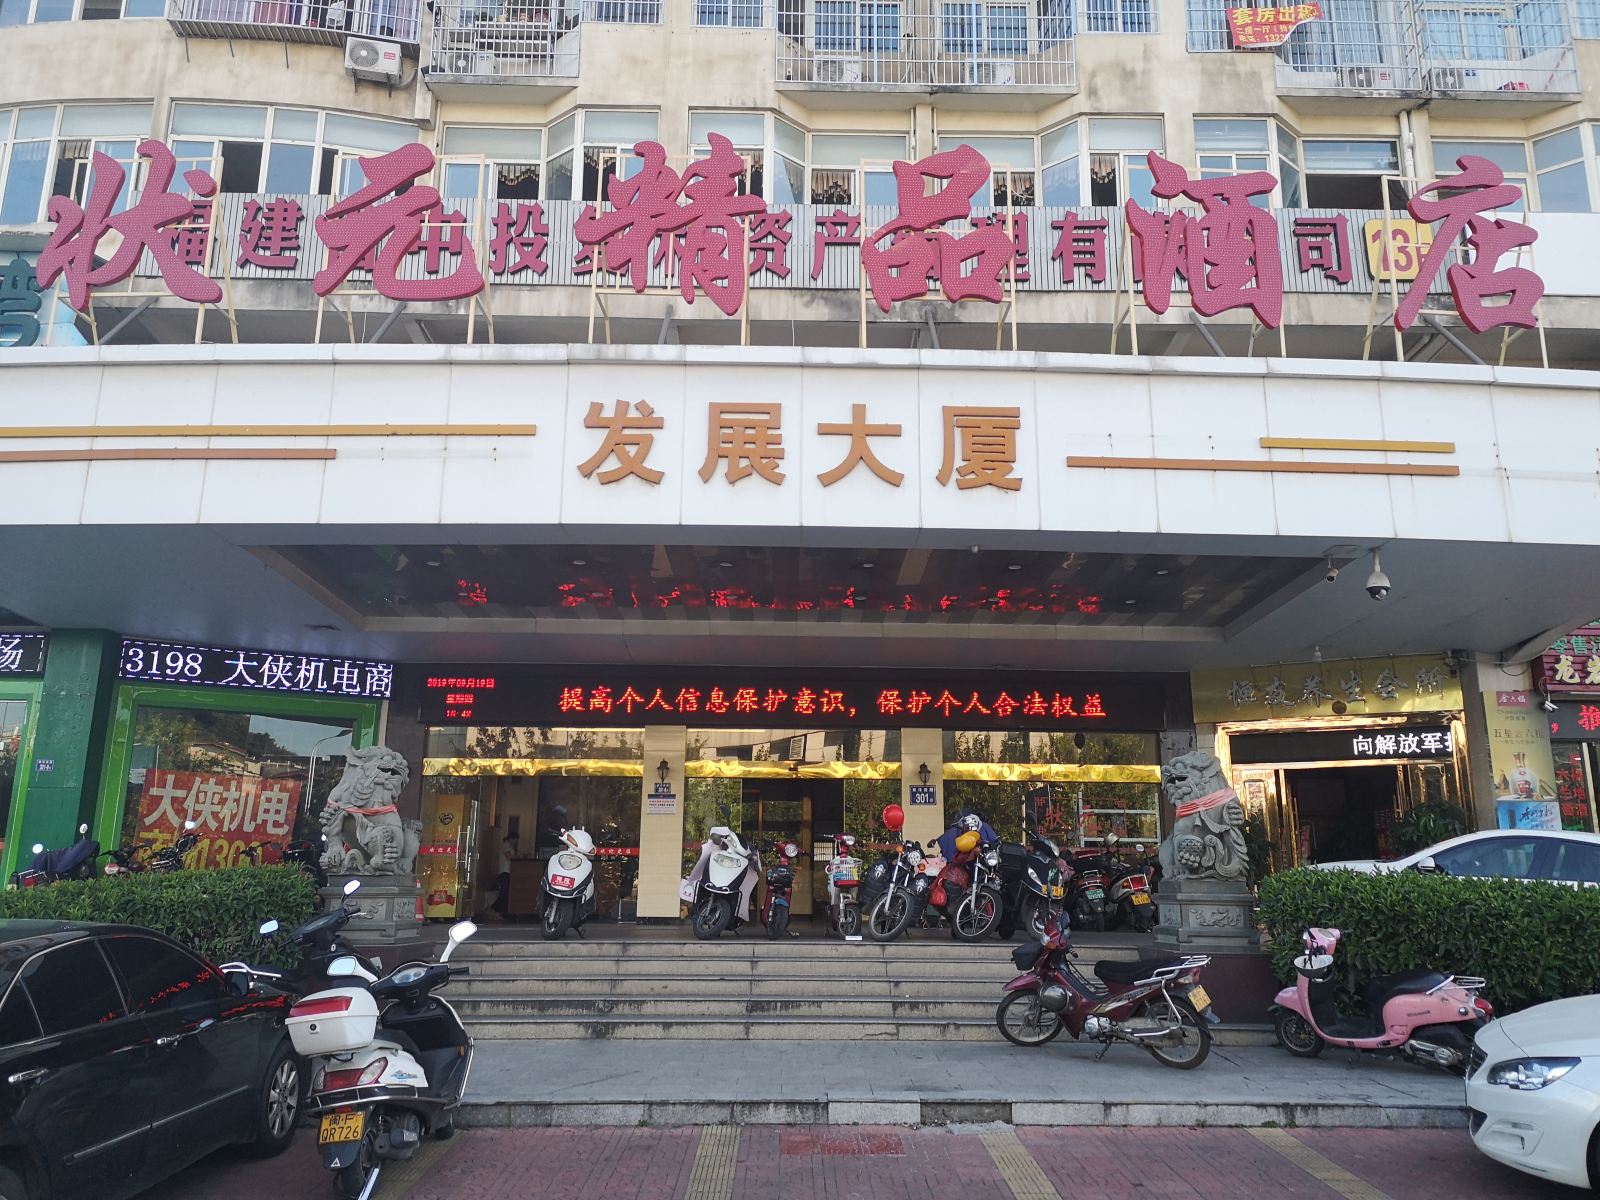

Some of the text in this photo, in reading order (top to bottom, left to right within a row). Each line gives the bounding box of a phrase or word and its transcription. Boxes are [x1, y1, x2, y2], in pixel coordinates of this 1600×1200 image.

[36, 132, 1545, 334] 状元精品酒店
[577, 399, 1023, 491] 发展大厦
[125, 647, 392, 695] 3198 大侠机电商
[143, 774, 290, 837] 大侠机电
[321, 1126, 360, 1143] QR726
